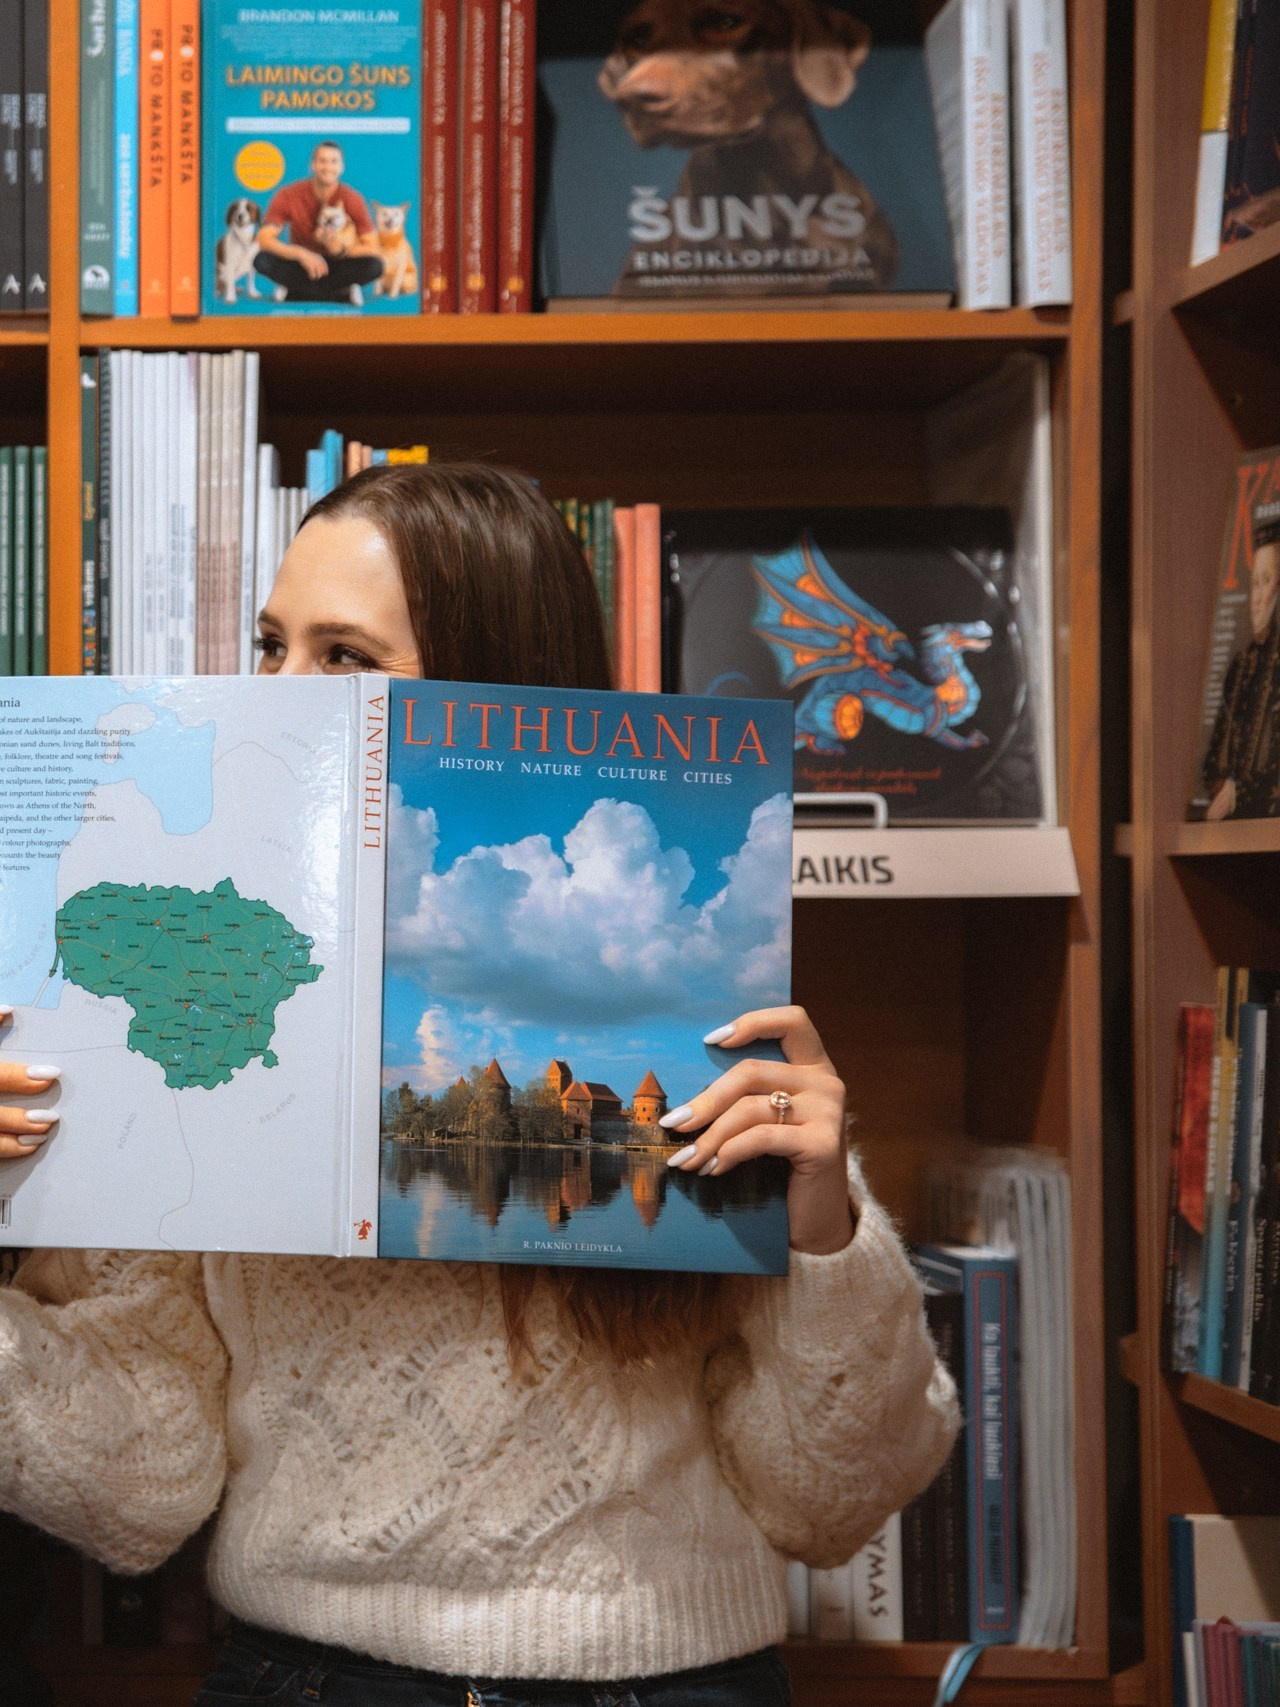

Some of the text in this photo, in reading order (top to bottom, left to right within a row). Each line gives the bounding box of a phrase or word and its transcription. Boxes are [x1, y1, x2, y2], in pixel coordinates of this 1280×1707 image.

[239, 9, 399, 23] BRANDON MCMILLAN
[226, 61, 410, 86] LAIMINGO ŠUNS
[261, 90, 375, 110] PAMOKOS
[151, 94, 167, 188] MANKŠTA
[181, 90, 197, 184] MANKŠTA
[628, 186, 866, 241] ŠUNYS
[633, 248, 871, 269] ENCIKLOPEDIJA
[24, 728, 61, 737] Aukštaitija
[77, 728, 108, 737] dazzling
[109, 728, 131, 737] purity
[403, 699, 770, 764] LITHUANIA
[20, 740, 37, 748] sand
[63, 740, 84, 749] living
[85, 740, 99, 748] Balt
[364, 695, 385, 848] LITHUANIA
[439, 757, 732, 784] HISTORY NATURE CULTURE CITIES
[9, 790, 44, 799] important
[73, 814, 94, 823] larger
[792, 855, 894, 884] AIKIS
[524, 1241, 622, 1253] R. PAKNIO LEIDYKLA
